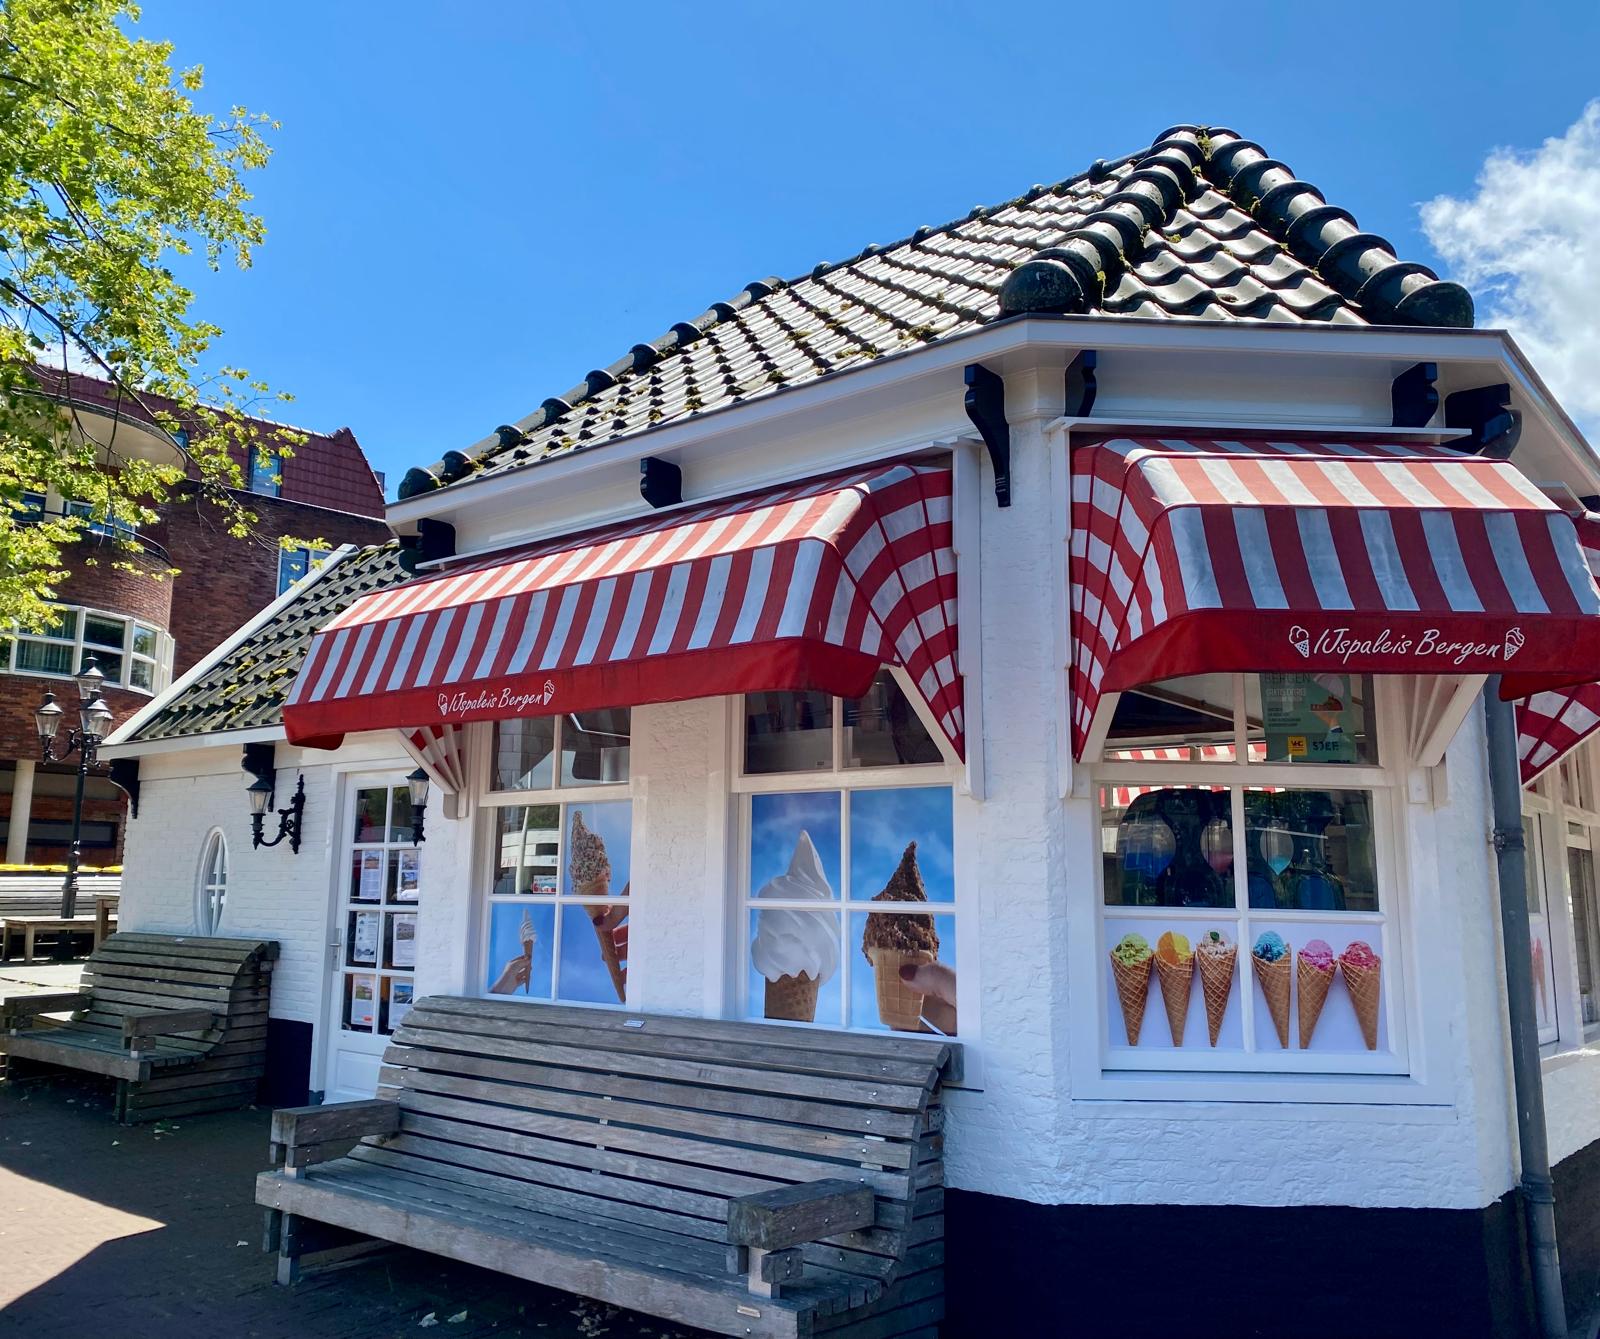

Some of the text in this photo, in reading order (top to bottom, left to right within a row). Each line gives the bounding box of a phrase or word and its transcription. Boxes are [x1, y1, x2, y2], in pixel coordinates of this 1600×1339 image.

[1313, 628, 1501, 665] IJspaleis Bergen
[498, 687, 542, 712] Bergen
